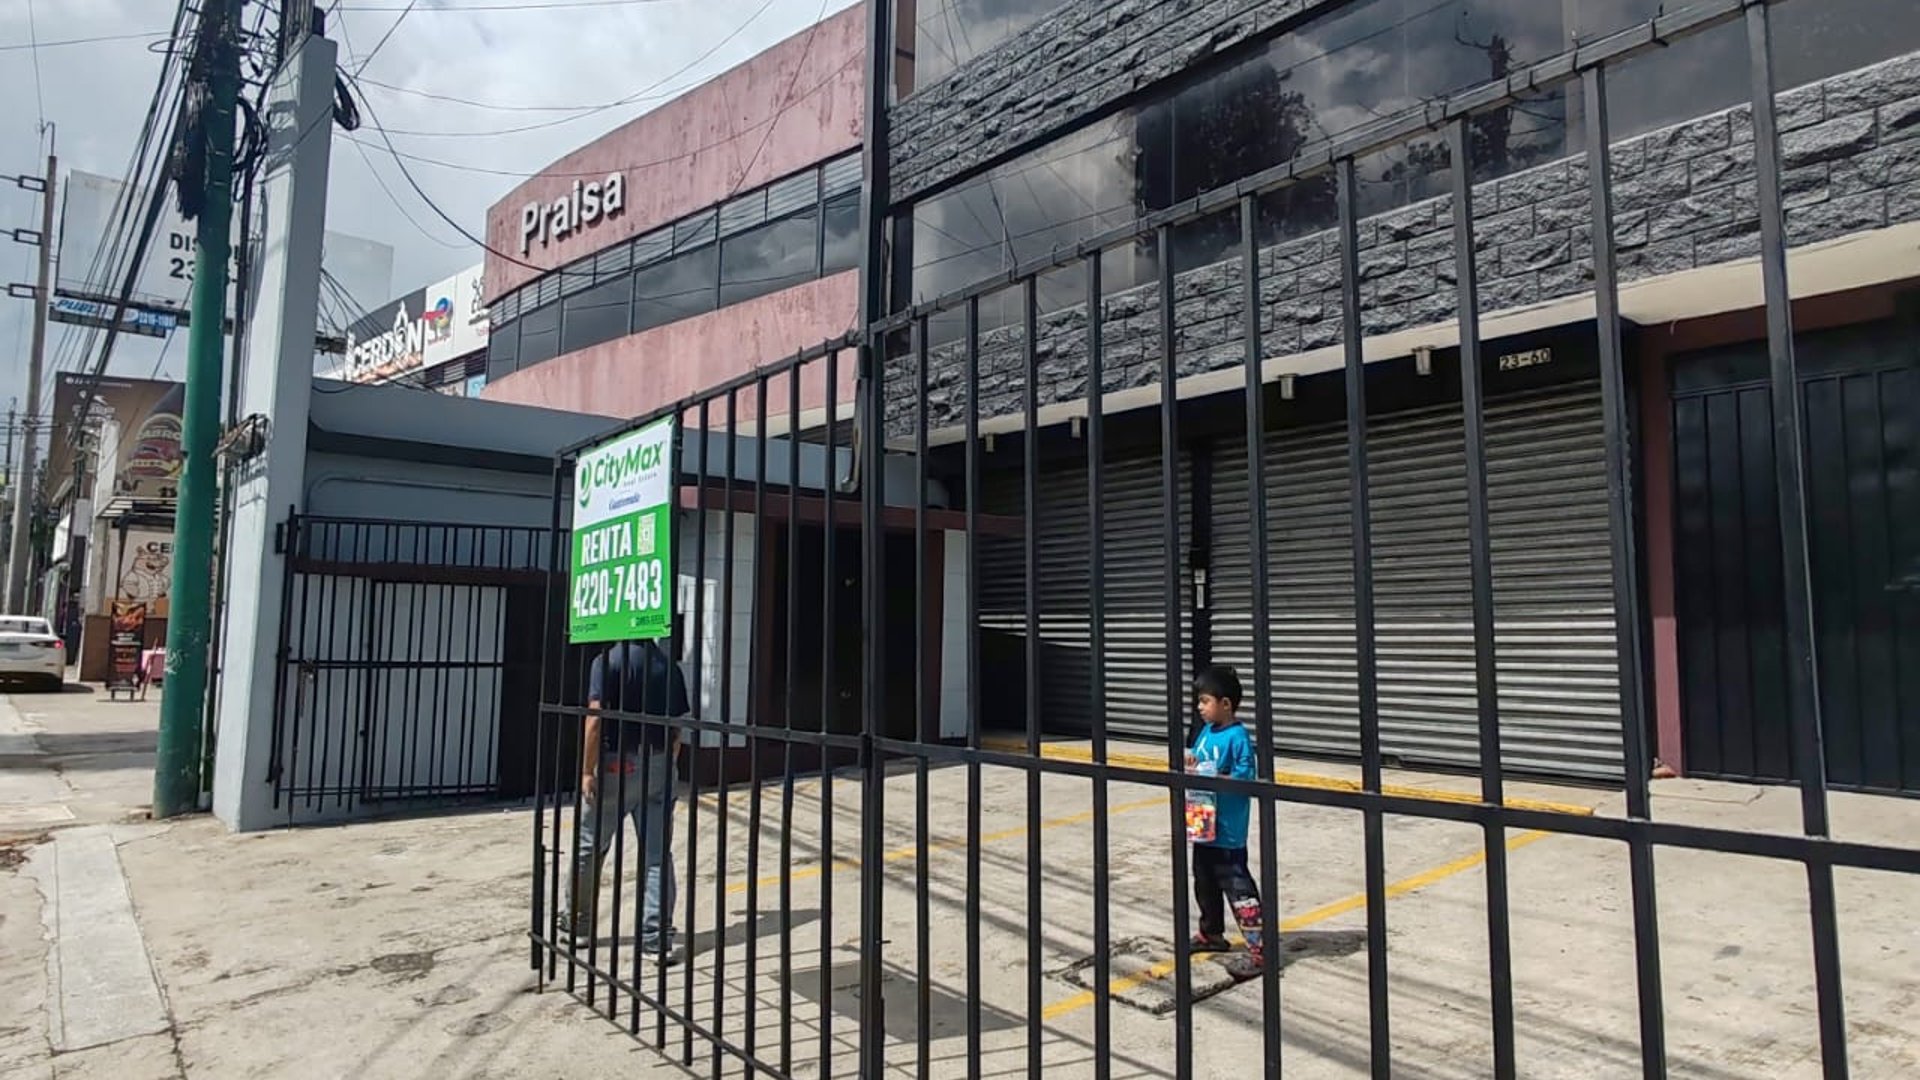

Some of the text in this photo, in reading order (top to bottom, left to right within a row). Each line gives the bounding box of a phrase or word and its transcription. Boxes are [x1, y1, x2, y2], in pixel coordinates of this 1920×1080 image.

[520, 171, 623, 255] Praisa
[1500, 349, 1550, 370] 23-60
[594, 441, 664, 490] CityMax
[146, 541, 174, 553] CE
[581, 521, 632, 567] RENTA
[573, 558, 663, 617] 4220-7483
